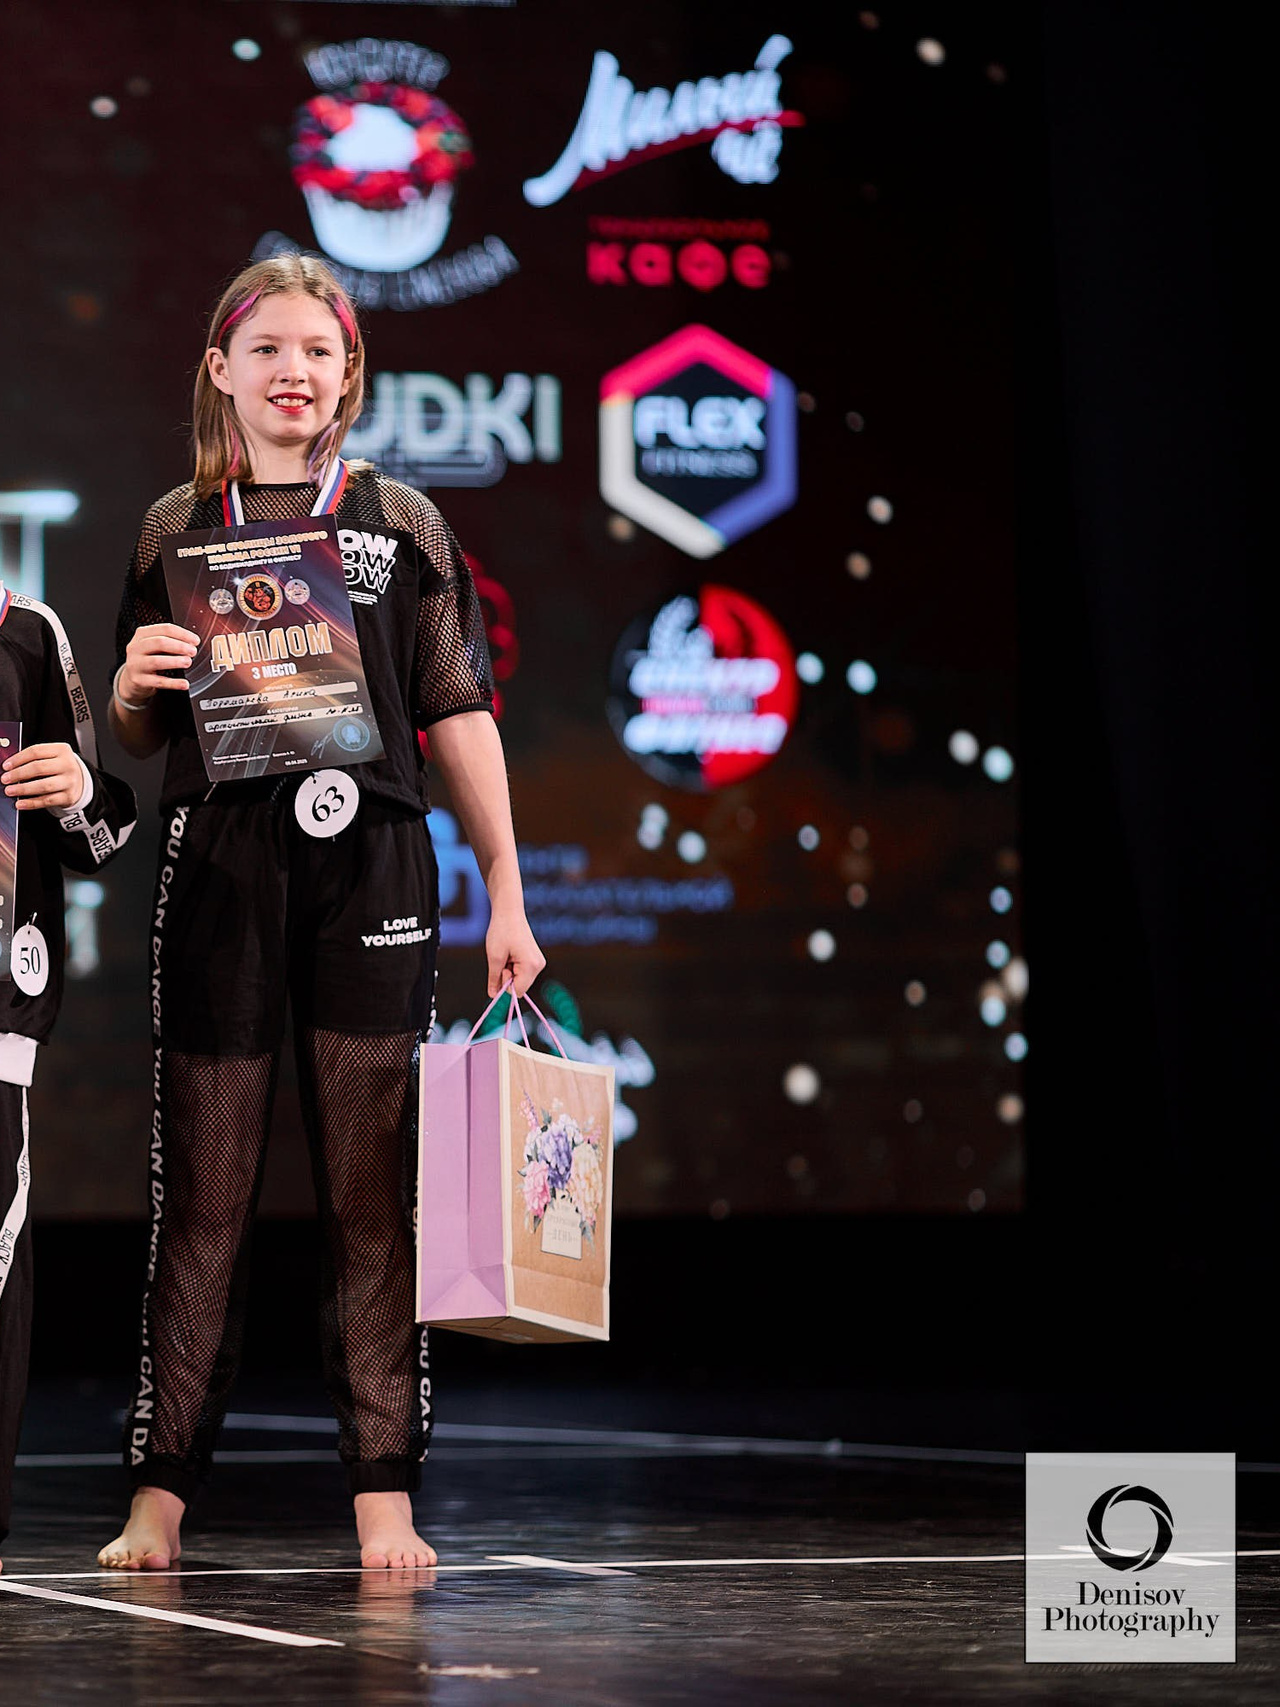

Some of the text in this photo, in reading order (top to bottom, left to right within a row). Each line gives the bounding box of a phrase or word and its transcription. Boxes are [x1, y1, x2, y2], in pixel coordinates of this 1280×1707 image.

[250, 546, 289, 560] РОССИИ
[210, 622, 333, 673] ДИПЛОМ
[252, 663, 298, 680] 3 МЕСТО
[60, 642, 91, 723] BLACK BEARS
[312, 786, 345, 822] 63
[167, 806, 190, 860] YOU
[154, 865, 174, 929] CAN
[361, 928, 432, 947] YOURSELF
[383, 916, 418, 931] LOVE
[20, 946, 40, 975] 50
[151, 935, 163, 1038] DANCE
[150, 1109, 164, 1176] CAN
[133, 1355, 154, 1420] CAN
